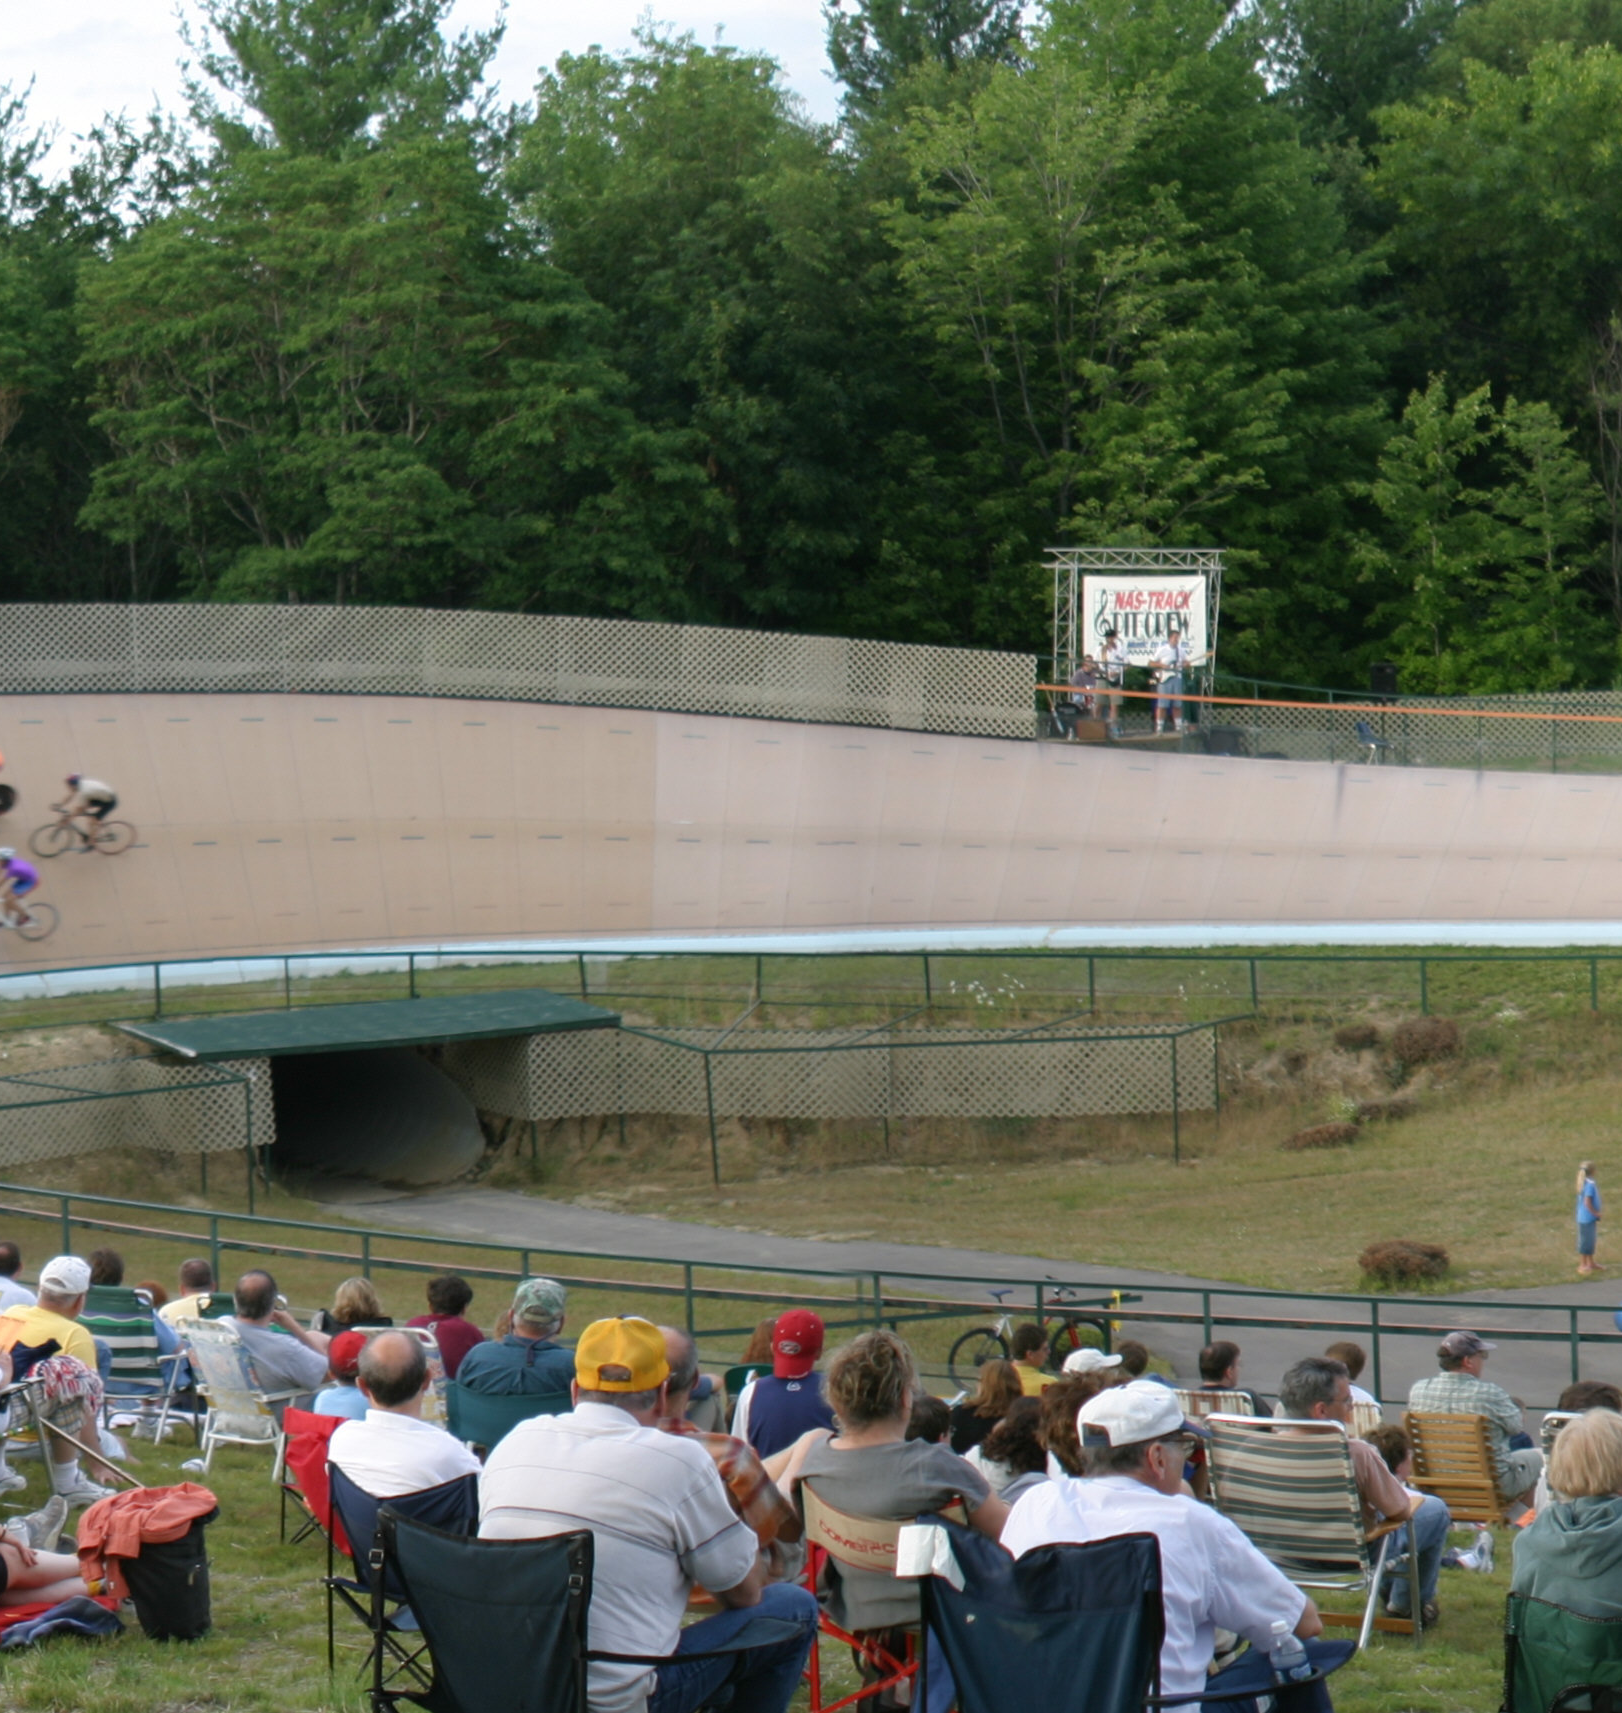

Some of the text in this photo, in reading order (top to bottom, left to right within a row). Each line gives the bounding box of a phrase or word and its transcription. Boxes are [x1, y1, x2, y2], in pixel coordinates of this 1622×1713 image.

[1114, 591, 1193, 610] NAS-TRACK
[1113, 611, 1192, 640] PIT CREW
